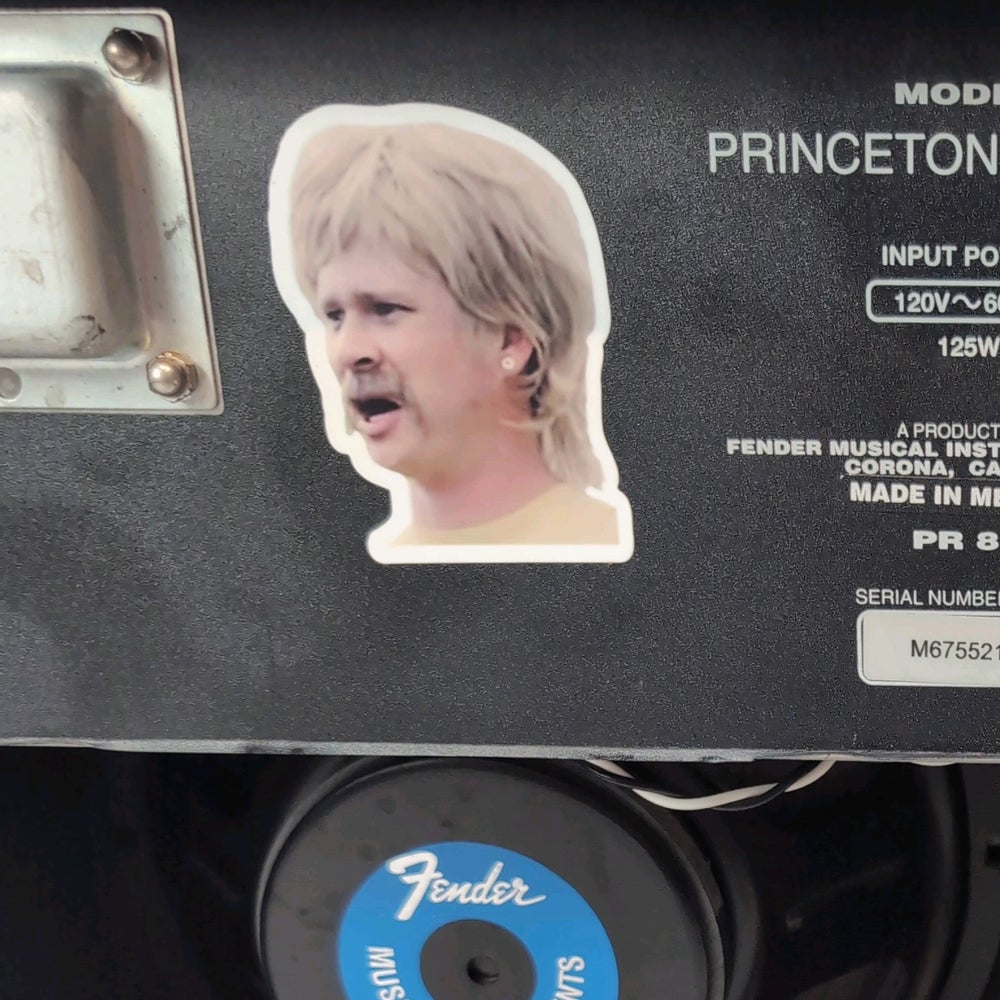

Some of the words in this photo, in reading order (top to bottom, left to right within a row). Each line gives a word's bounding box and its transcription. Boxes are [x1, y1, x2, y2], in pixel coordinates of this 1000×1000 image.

[708, 130, 998, 176] PRINCETON
[881, 244, 958, 267] INPUT
[937, 335, 1000, 358] 125W
[896, 423, 909, 439] A
[913, 423, 1000, 440] PRODUCT
[726, 438, 823, 456] FENDER
[829, 439, 939, 457] MUSICAL
[844, 459, 955, 479] CORONA,
[849, 481, 926, 504] MADE
[933, 484, 962, 506] IN
[912, 529, 964, 551] PR
[855, 588, 922, 606] SERIAL
[386, 850, 547, 921] Fender
